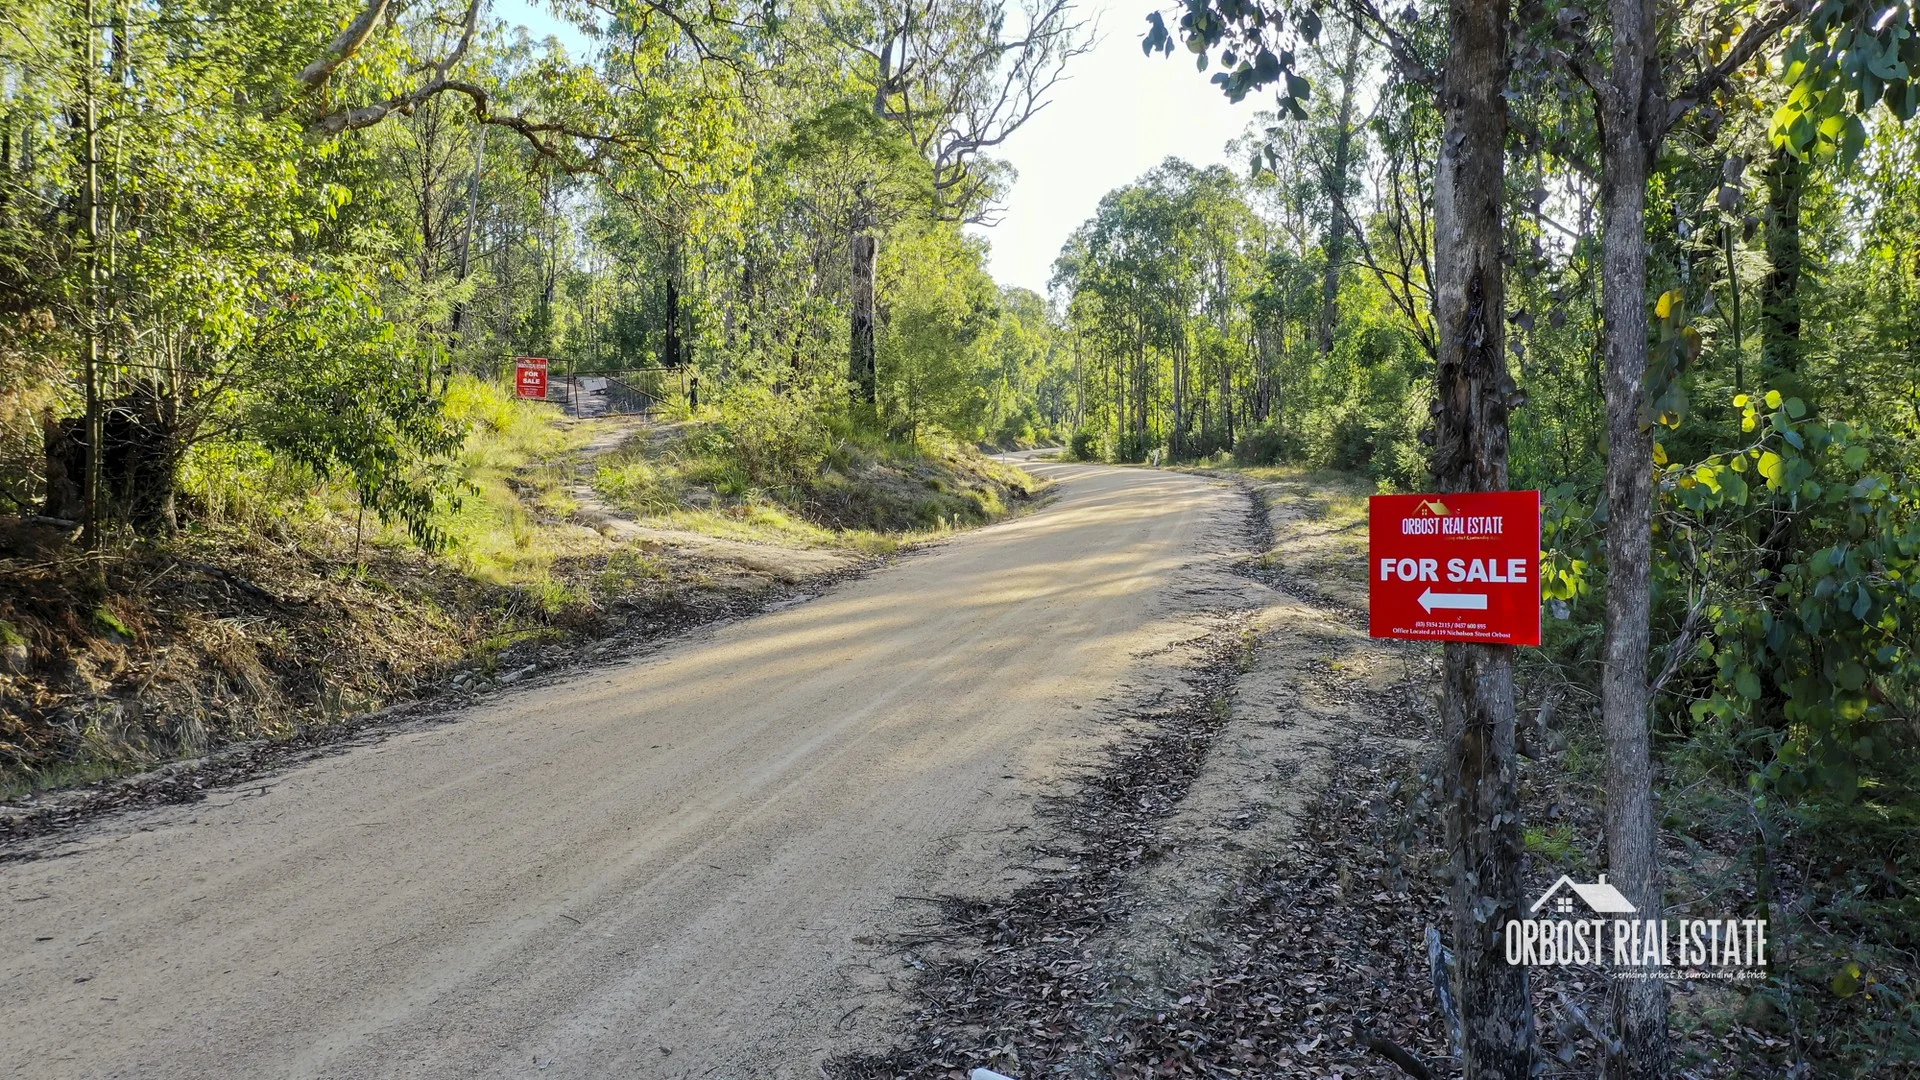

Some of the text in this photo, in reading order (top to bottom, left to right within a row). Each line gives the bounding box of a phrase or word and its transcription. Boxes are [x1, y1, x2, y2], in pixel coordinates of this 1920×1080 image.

[1402, 516, 1503, 535] ORBOST REAL ESTATE
[1380, 558, 1527, 583] FOR SALE
